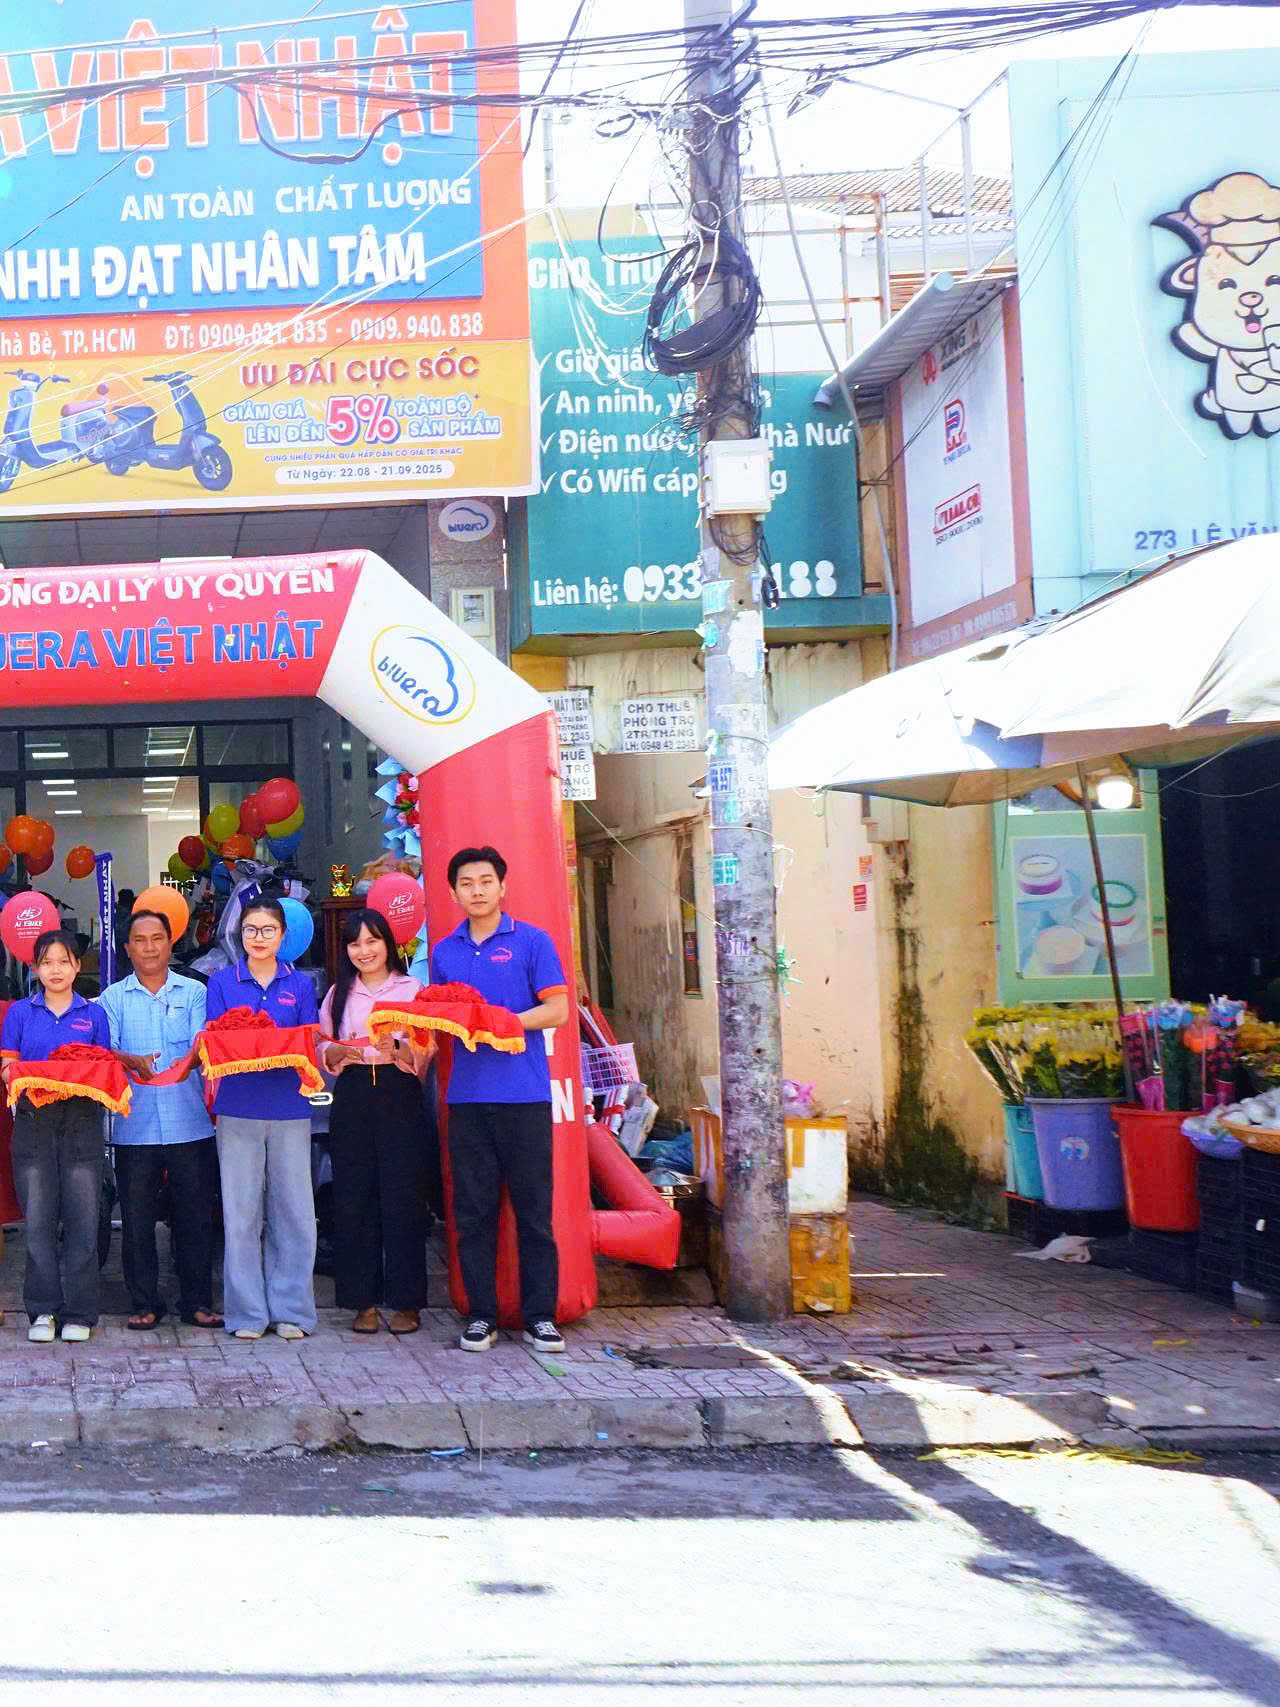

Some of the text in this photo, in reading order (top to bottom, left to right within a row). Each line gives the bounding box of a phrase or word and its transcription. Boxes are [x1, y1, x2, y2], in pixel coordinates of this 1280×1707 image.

[31, 18, 223, 180] VIỆT
[236, 5, 468, 166] NHẬT
[120, 175, 472, 222] AN TOÀN CHẤT LƯỢNG
[92, 243, 183, 309] ĐẠT
[191, 229, 321, 292] NHÂN
[328, 223, 427, 287] TÂM
[528, 256, 589, 288] CHO
[29, 330, 56, 360] Bè,
[64, 327, 135, 353] TP.HCM
[165, 325, 194, 349] ĐT:
[241, 347, 480, 387] ƯU ĐÃI CỰC SỐC
[224, 399, 306, 421] GIẢM GIÁ
[395, 393, 471, 417] TOÀN BỘ
[555, 389, 661, 415] An ninh,
[246, 420, 324, 444] LÊN ĐẾN
[326, 394, 401, 446] 5%
[409, 412, 501, 437] SẢN PHẨM
[558, 428, 618, 460] Điện
[287, 464, 442, 481] Từ Ngày: 22.08 21.09.2025
[559, 467, 698, 497] Có Wifi cáp
[1135, 523, 1221, 550] 273 LÊ
[58, 582, 111, 609] ĐẠI
[120, 576, 152, 602] LÝ
[534, 577, 618, 610] Liên hệ:
[103, 616, 208, 672] VIỆT
[213, 610, 323, 669] NHẬT
[624, 715, 666, 728] PHÒNG
[628, 703, 653, 714] CHO
[561, 747, 586, 761] HUÊ
